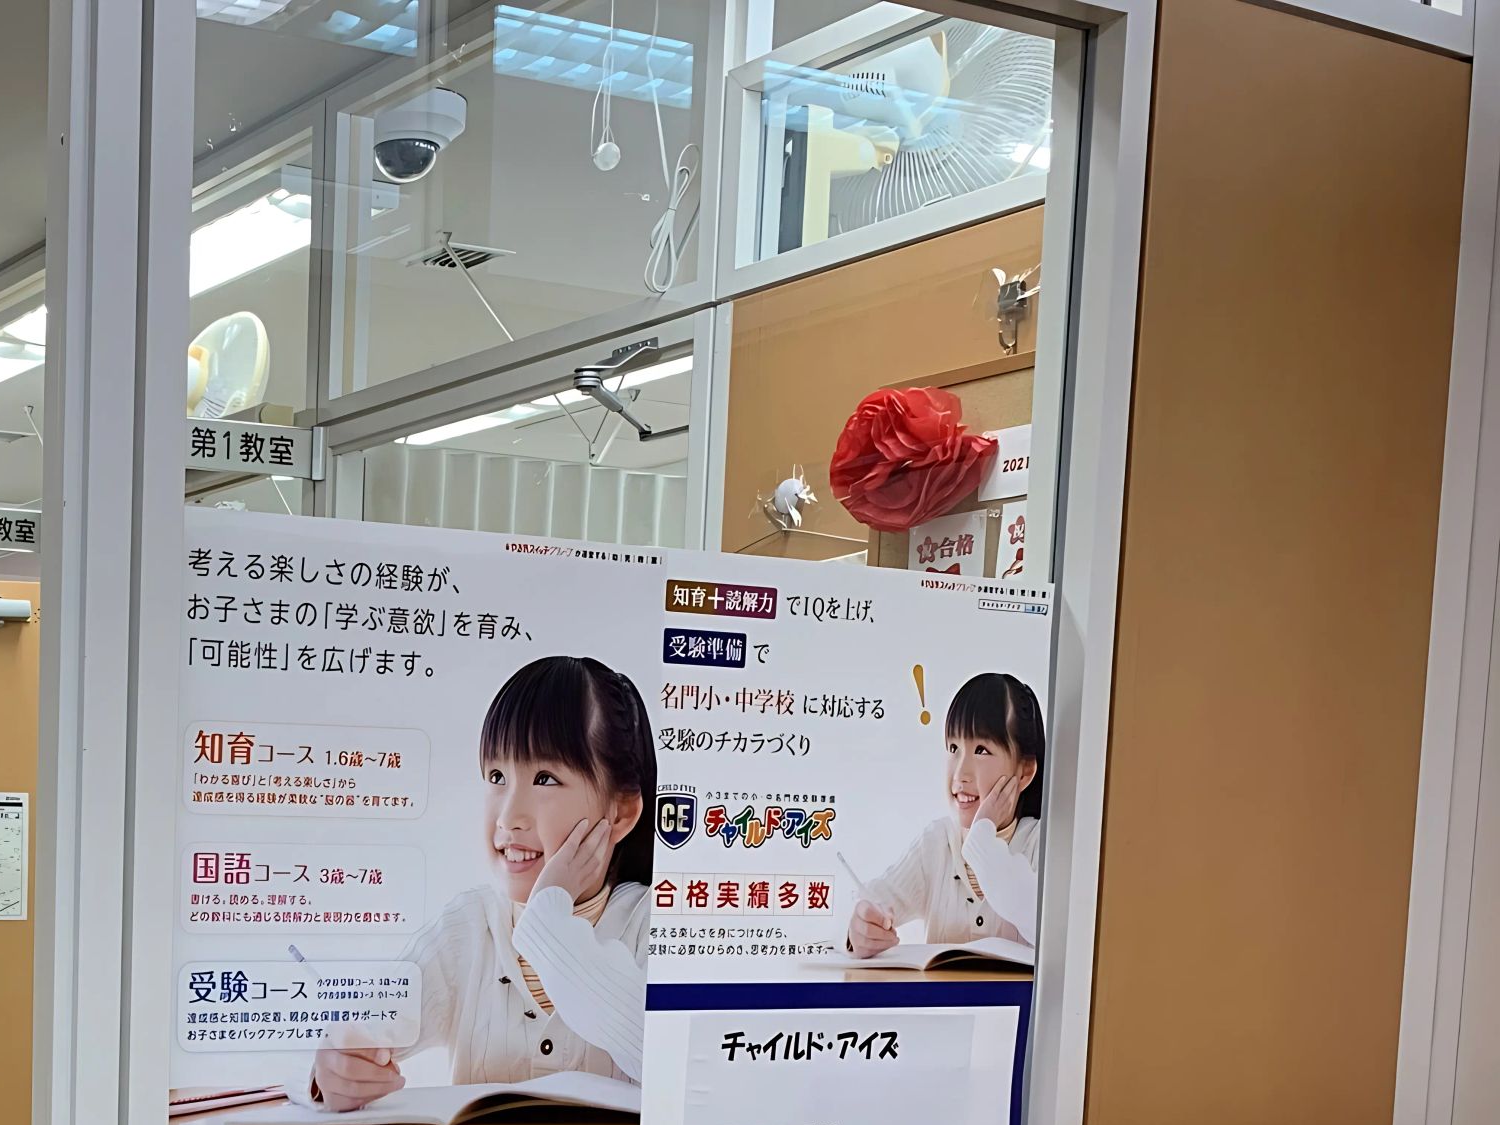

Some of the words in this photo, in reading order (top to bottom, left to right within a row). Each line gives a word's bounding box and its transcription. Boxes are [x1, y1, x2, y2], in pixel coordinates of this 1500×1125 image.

[191, 426, 294, 466] 第1教室
[187, 547, 461, 595] 考える楽しさの経験が、
[186, 592, 534, 642] お子さまの「学ぶ意欲」を育み、
[672, 584, 774, 615] 知育+読解力
[786, 595, 875, 624] でIQを上げ、
[187, 637, 435, 679] 「可能性」を広げます。
[668, 634, 743, 663] 受験準備
[753, 643, 770, 664] で
[660, 682, 795, 716] 名門小・中学校
[803, 694, 886, 720] に対応する
[193, 730, 315, 765] 知育コース
[658, 727, 811, 757] 受験のチカラづくり
[661, 803, 691, 833] CE
[192, 852, 311, 885] 国語コース
[653, 879, 831, 910] 合格実績多数
[188, 970, 308, 1004] 受験コース
[720, 1030, 900, 1062] チャイルド・アイズ
